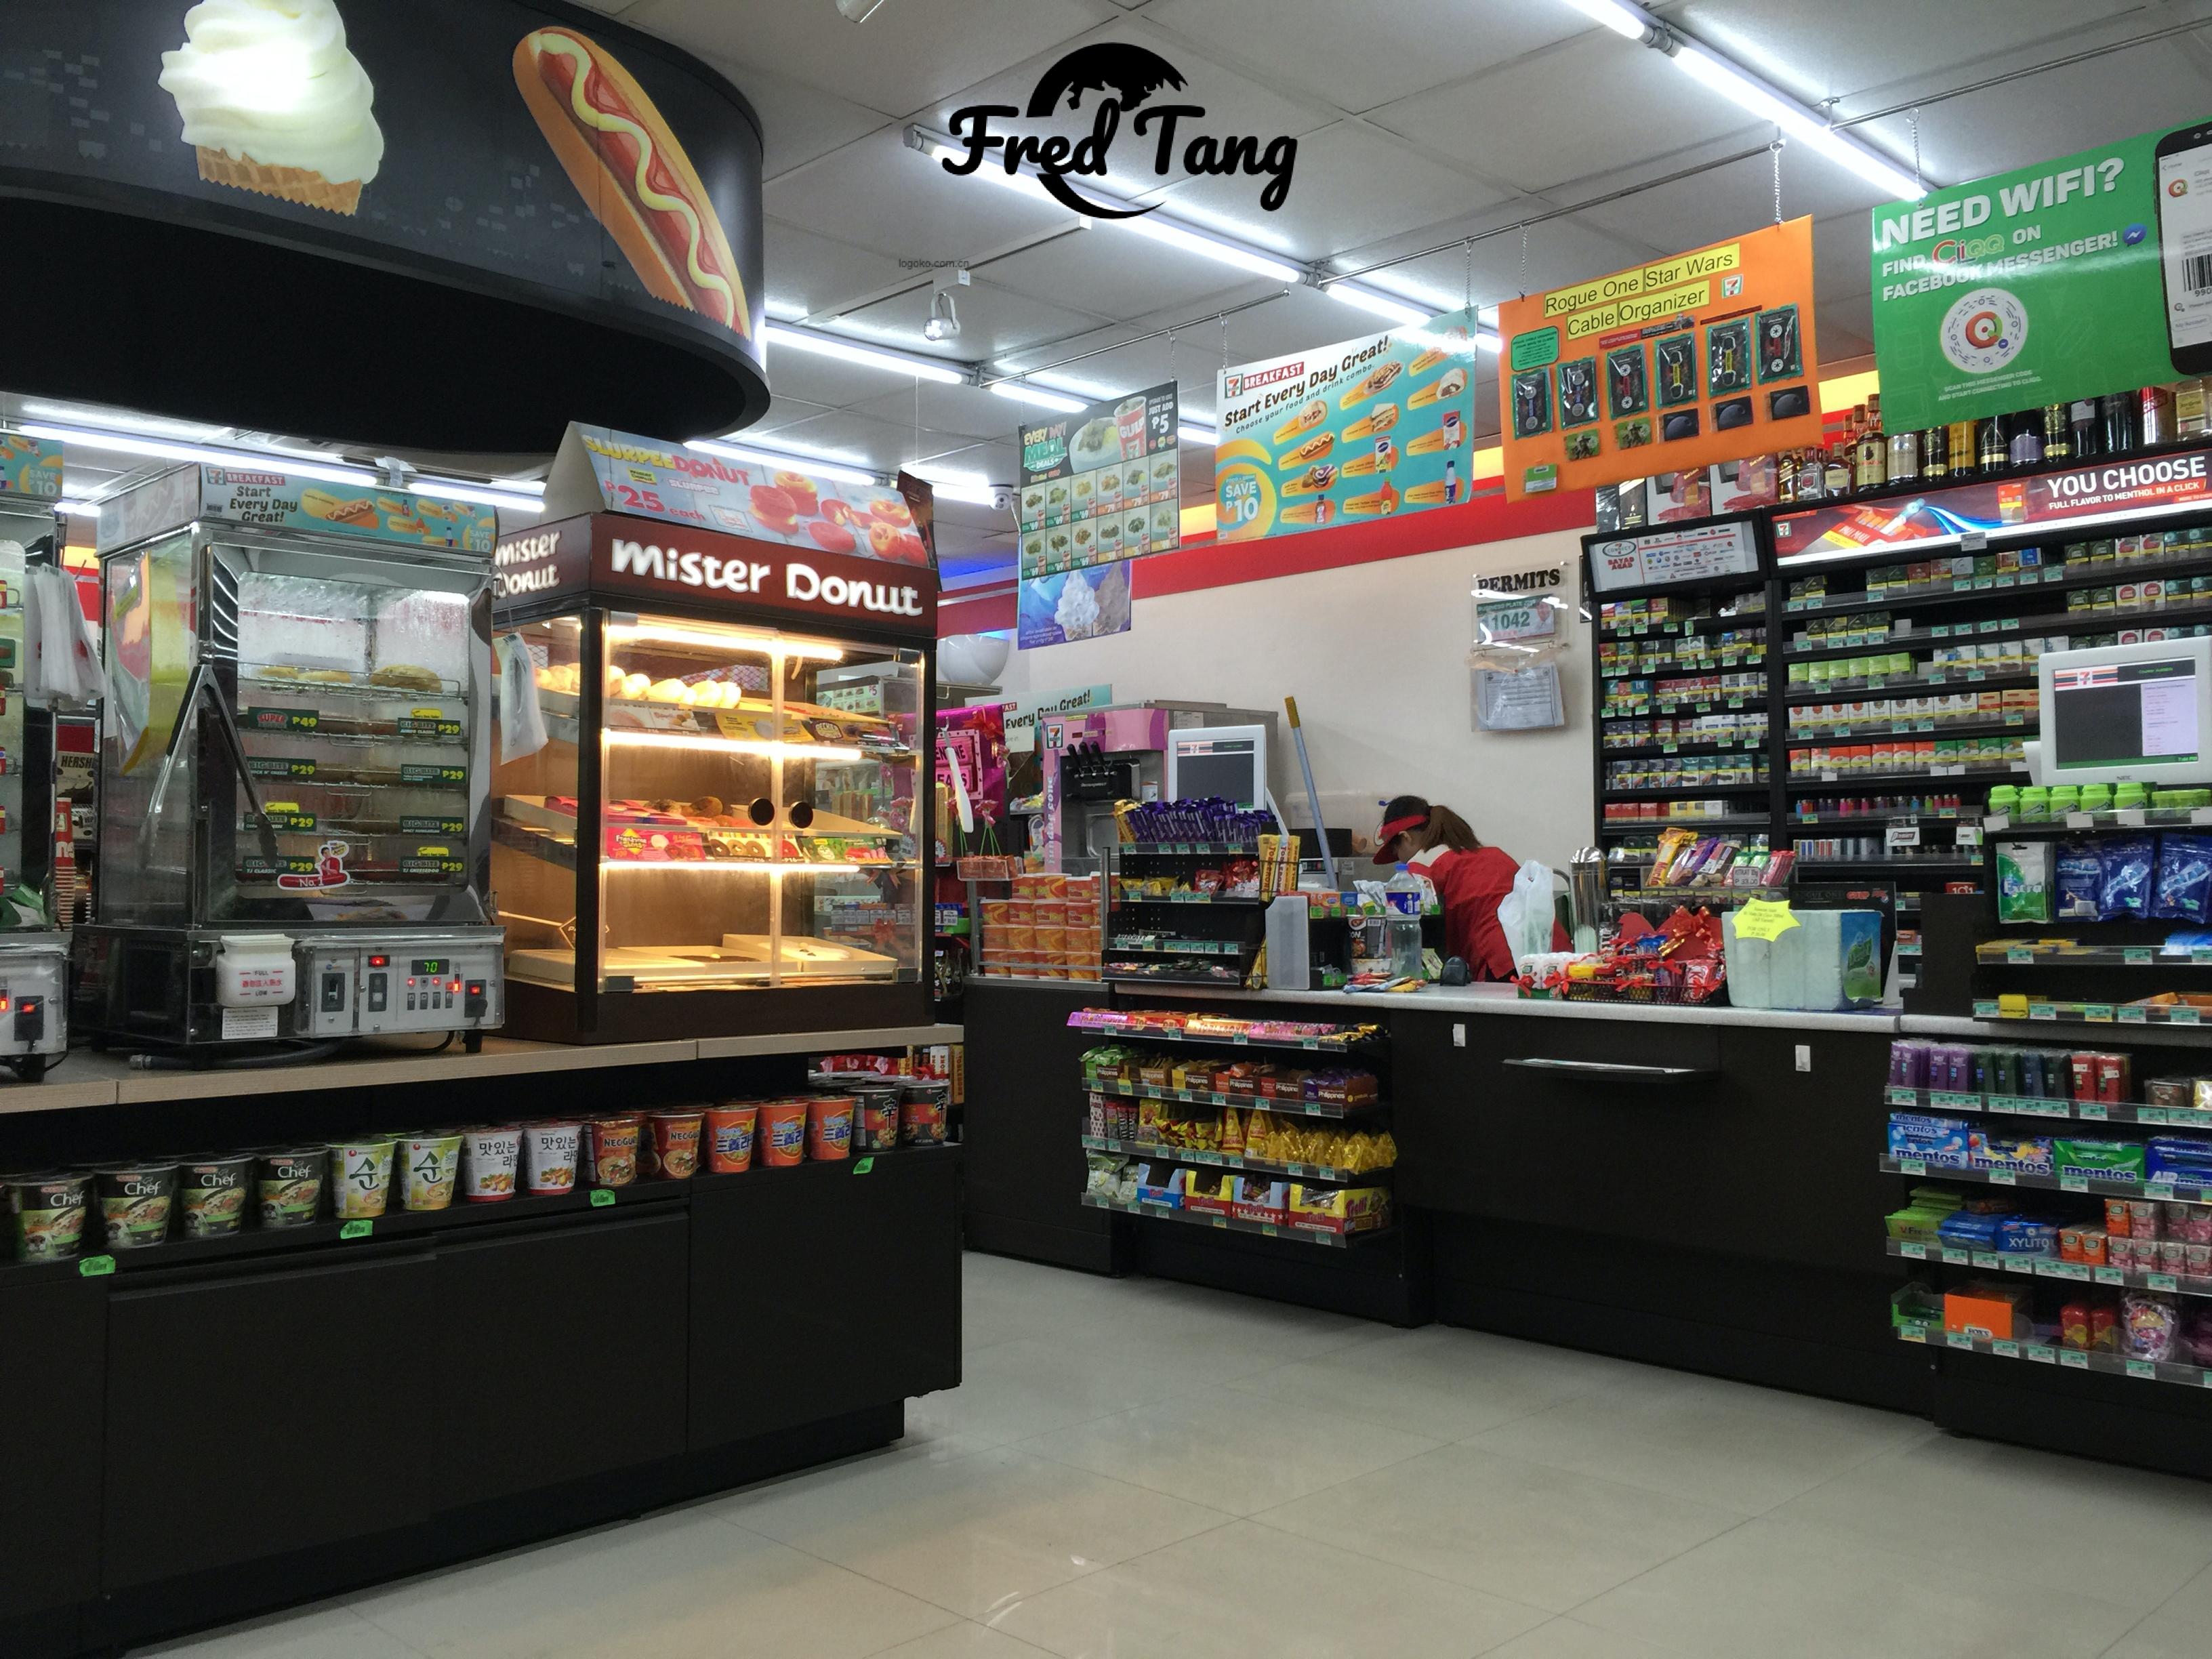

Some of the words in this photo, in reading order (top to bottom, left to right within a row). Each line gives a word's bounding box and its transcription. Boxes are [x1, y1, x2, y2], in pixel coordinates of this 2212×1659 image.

[1882, 194, 1991, 249] NEED
[1999, 158, 2124, 217] WIFI?
[1883, 255, 1926, 276] FIND
[2012, 225, 2041, 245] ON
[1883, 264, 1984, 301] FACEBOOK
[1986, 231, 2118, 273] MESSENGER!
[1544, 290, 1597, 315] Rogue
[1603, 276, 1639, 296] One
[1645, 265, 1681, 287] Star
[1686, 250, 1734, 276] Wars
[1567, 308, 1616, 336] Cable
[1619, 286, 1705, 322] Organizer
[1225, 398, 1261, 427] Start
[1265, 382, 1304, 409] Every
[1309, 365, 1337, 388] Day
[1342, 335, 1389, 370] Great!
[1244, 364, 1303, 390] BREAKFAST
[1236, 416, 1263, 434] Choose
[1265, 407, 1283, 422] your
[1286, 396, 1304, 411] food
[1305, 389, 1320, 402] and
[1322, 380, 1343, 394] drink
[1346, 364, 1375, 382] combo.
[1149, 405, 1161, 415] JUST
[1162, 401, 1174, 410] ADD
[1024, 426, 1048, 445] EVERY
[1119, 417, 1145, 438] GULP
[1024, 437, 1067, 464] MEAL
[582, 434, 675, 468] SLURPEE
[671, 455, 752, 485] DONUT
[1036, 459, 1054, 470] DEALS
[30, 470, 56, 480] SAVE
[227, 473, 283, 485] BREAKFAST
[2047, 472, 2097, 498] YOU
[2103, 456, 2207, 489] CHOOSE
[237, 486, 271, 497] Start
[1225, 481, 1256, 498] SAVE
[2049, 499, 2070, 510] FULL
[2071, 495, 2102, 508] FLAVOR
[2102, 493, 2114, 502] TO
[2114, 486, 2156, 500] MENTHOL
[2156, 486, 2166, 495] IN
[2167, 485, 2174, 493] A
[2174, 481, 2200, 492] CLICK
[230, 498, 268, 512] Every
[272, 499, 298, 512] Day
[242, 511, 284, 522] Great!
[670, 508, 706, 520] each
[470, 531, 489, 539] SAVE
[1839, 525, 1853, 536] PALL
[1852, 529, 1870, 541] MALL
[786, 562, 924, 616] Donut
[1477, 569, 1561, 593] PERMITS
[1492, 611, 1531, 630] 1042
[1006, 713, 1035, 729] Every
[1060, 690, 1090, 711] Great!
[292, 716, 317, 727] P49
[438, 724, 459, 734] P29
[61, 756, 94, 769] HERSH
[291, 765, 315, 775] P29
[442, 770, 464, 780] P29
[290, 817, 314, 827] P29
[442, 823, 463, 832] P29
[289, 862, 314, 872] P29
[442, 862, 464, 872] P29
[299, 878, 316, 887] No.
[2003, 881, 2042, 895] Extra
[423, 962, 438, 973] 70
[1229, 1080, 1254, 1088] Philippines
[1275, 1084, 1298, 1092] Philippine
[1318, 1091, 1345, 1099] Philippines
[478, 1141, 516, 1157] 맛있는
[541, 1136, 577, 1150] 맛있는
[1894, 1149, 1960, 1166] mentos
[277, 1164, 312, 1179] Chef
[349, 1157, 380, 1191] 순
[413, 1151, 444, 1184] 순
[1973, 1157, 2051, 1176] mentos
[2062, 1166, 2137, 1183] mentos
[201, 1172, 237, 1188] Chef
[124, 1181, 162, 1196] Chef
[49, 1191, 85, 1207] Chef
